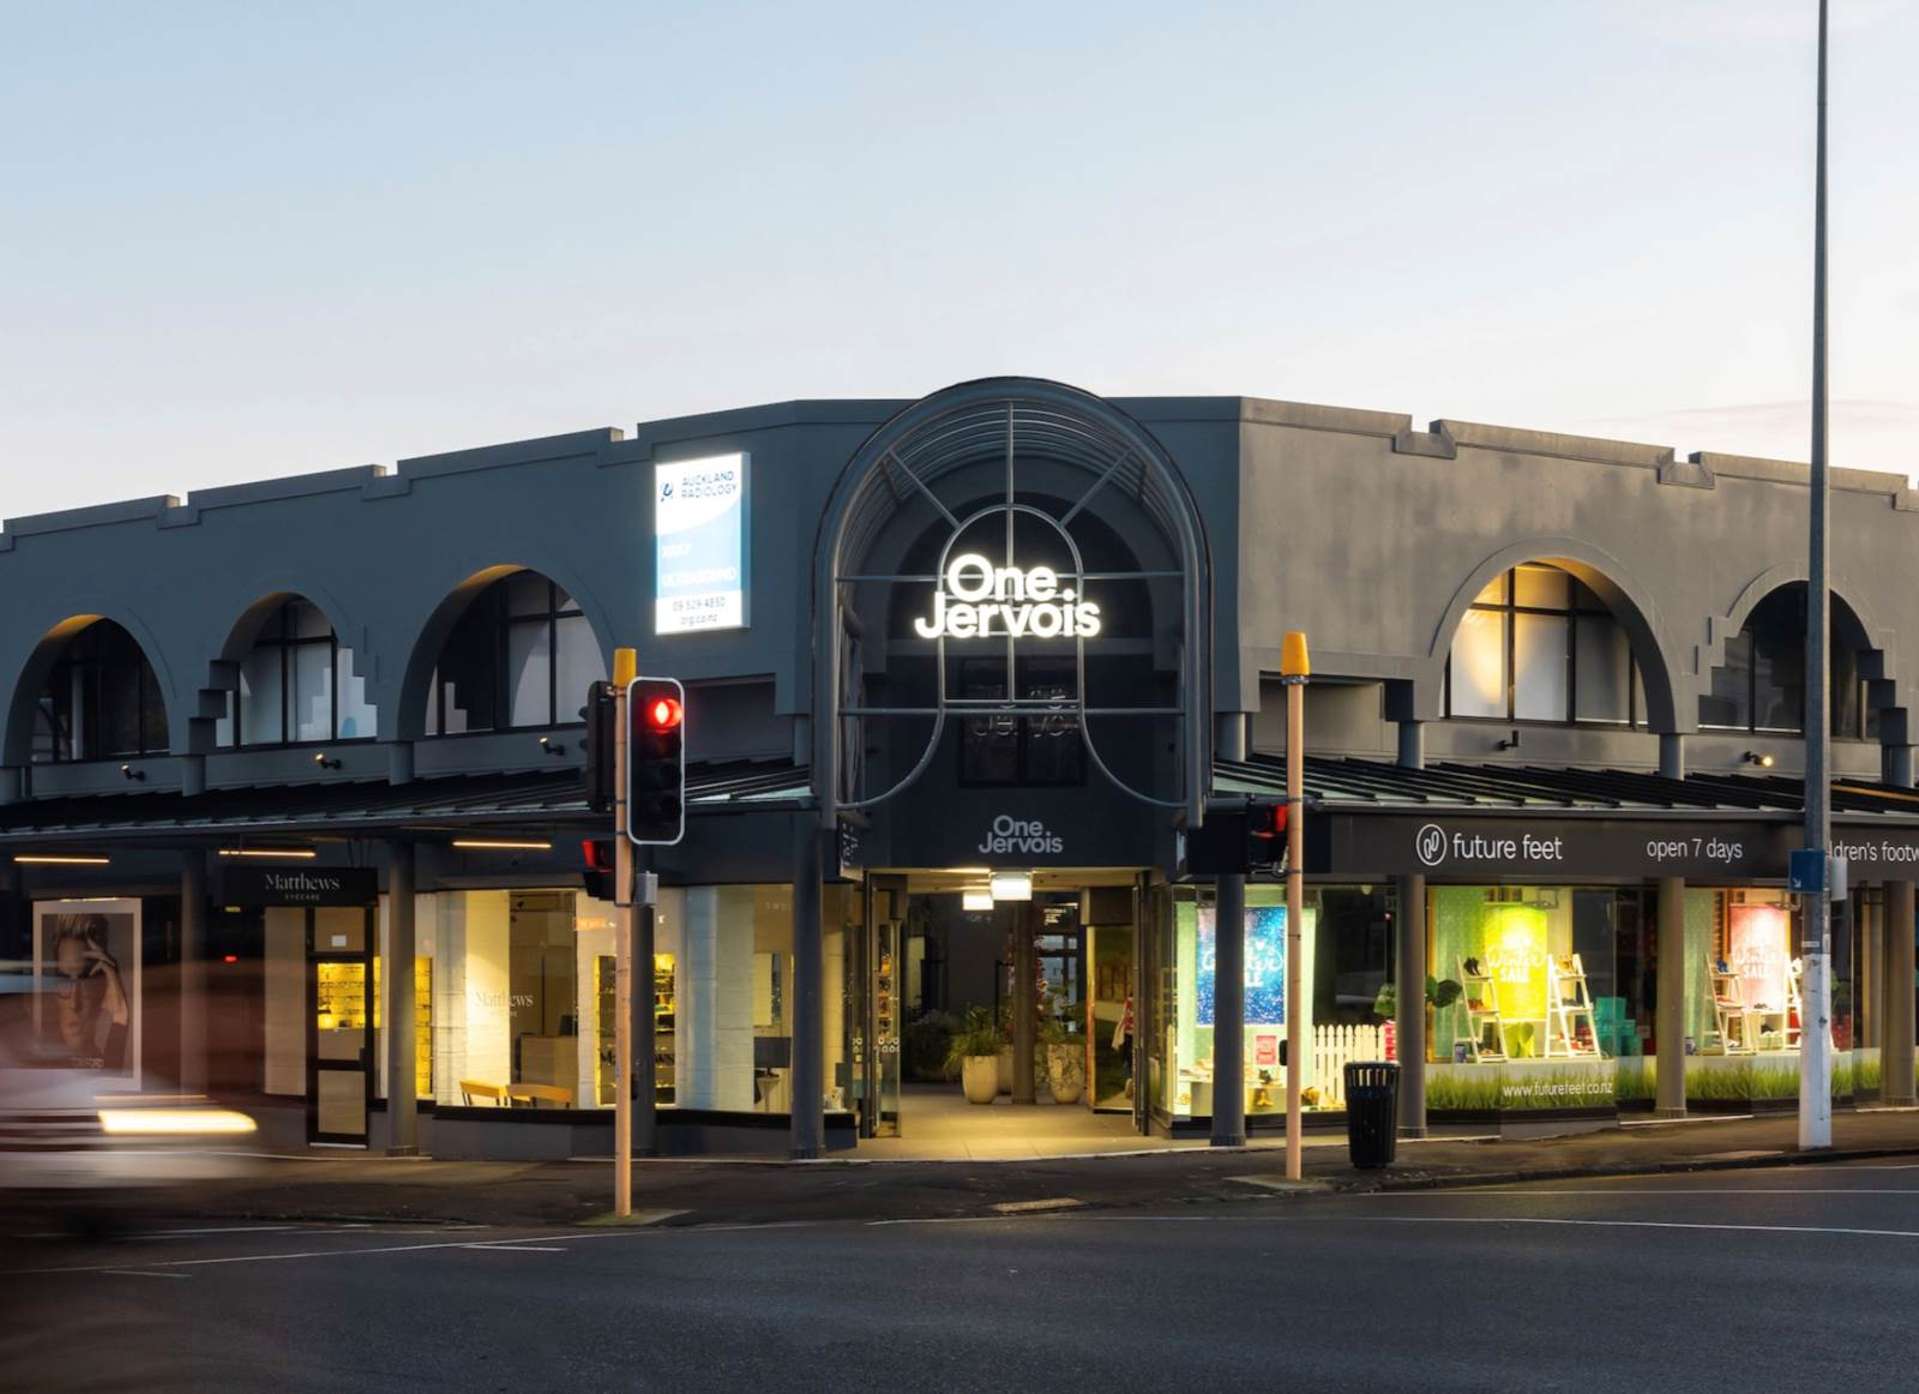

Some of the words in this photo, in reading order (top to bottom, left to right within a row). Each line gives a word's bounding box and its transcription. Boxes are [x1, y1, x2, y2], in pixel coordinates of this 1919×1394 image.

[948, 553, 1057, 601] One
[914, 589, 1101, 638] Jervois
[993, 815, 1043, 837] One
[979, 831, 1064, 853] Jervois
[1453, 833, 1516, 859] future
[1522, 834, 1563, 860] feet
[1647, 840, 1688, 862] open
[1691, 838, 1703, 857] 7
[1706, 837, 1743, 863] days
[1827, 840, 1878, 861] ldren's
[265, 872, 340, 890] Matthews
